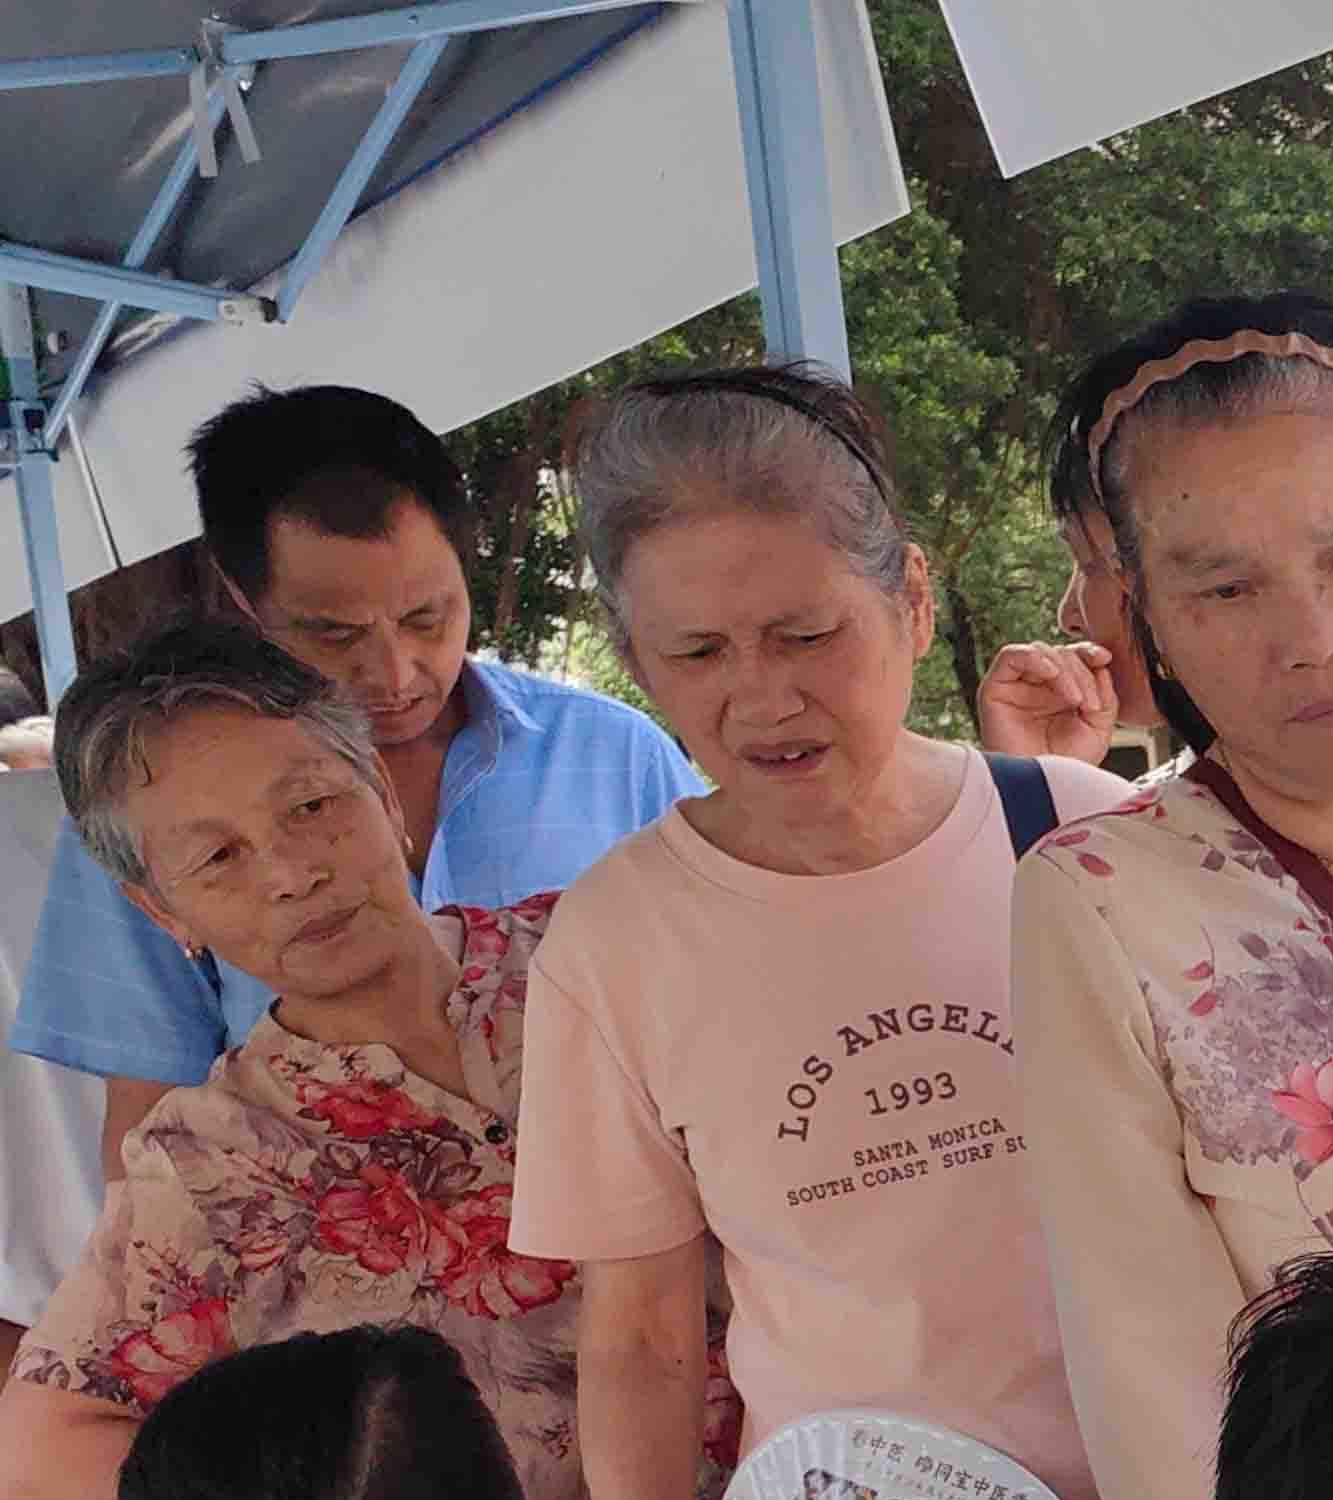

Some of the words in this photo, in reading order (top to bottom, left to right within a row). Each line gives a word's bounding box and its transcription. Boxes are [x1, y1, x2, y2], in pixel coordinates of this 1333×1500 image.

[777, 1055, 833, 1142] LOS
[864, 1072, 957, 1116] 1993
[853, 1139, 919, 1168] SANTA
[928, 1117, 1006, 1151] MONICA
[786, 1177, 857, 1207] SOUTH
[862, 1159, 929, 1189] COAST
[942, 1143, 995, 1169] SURF
